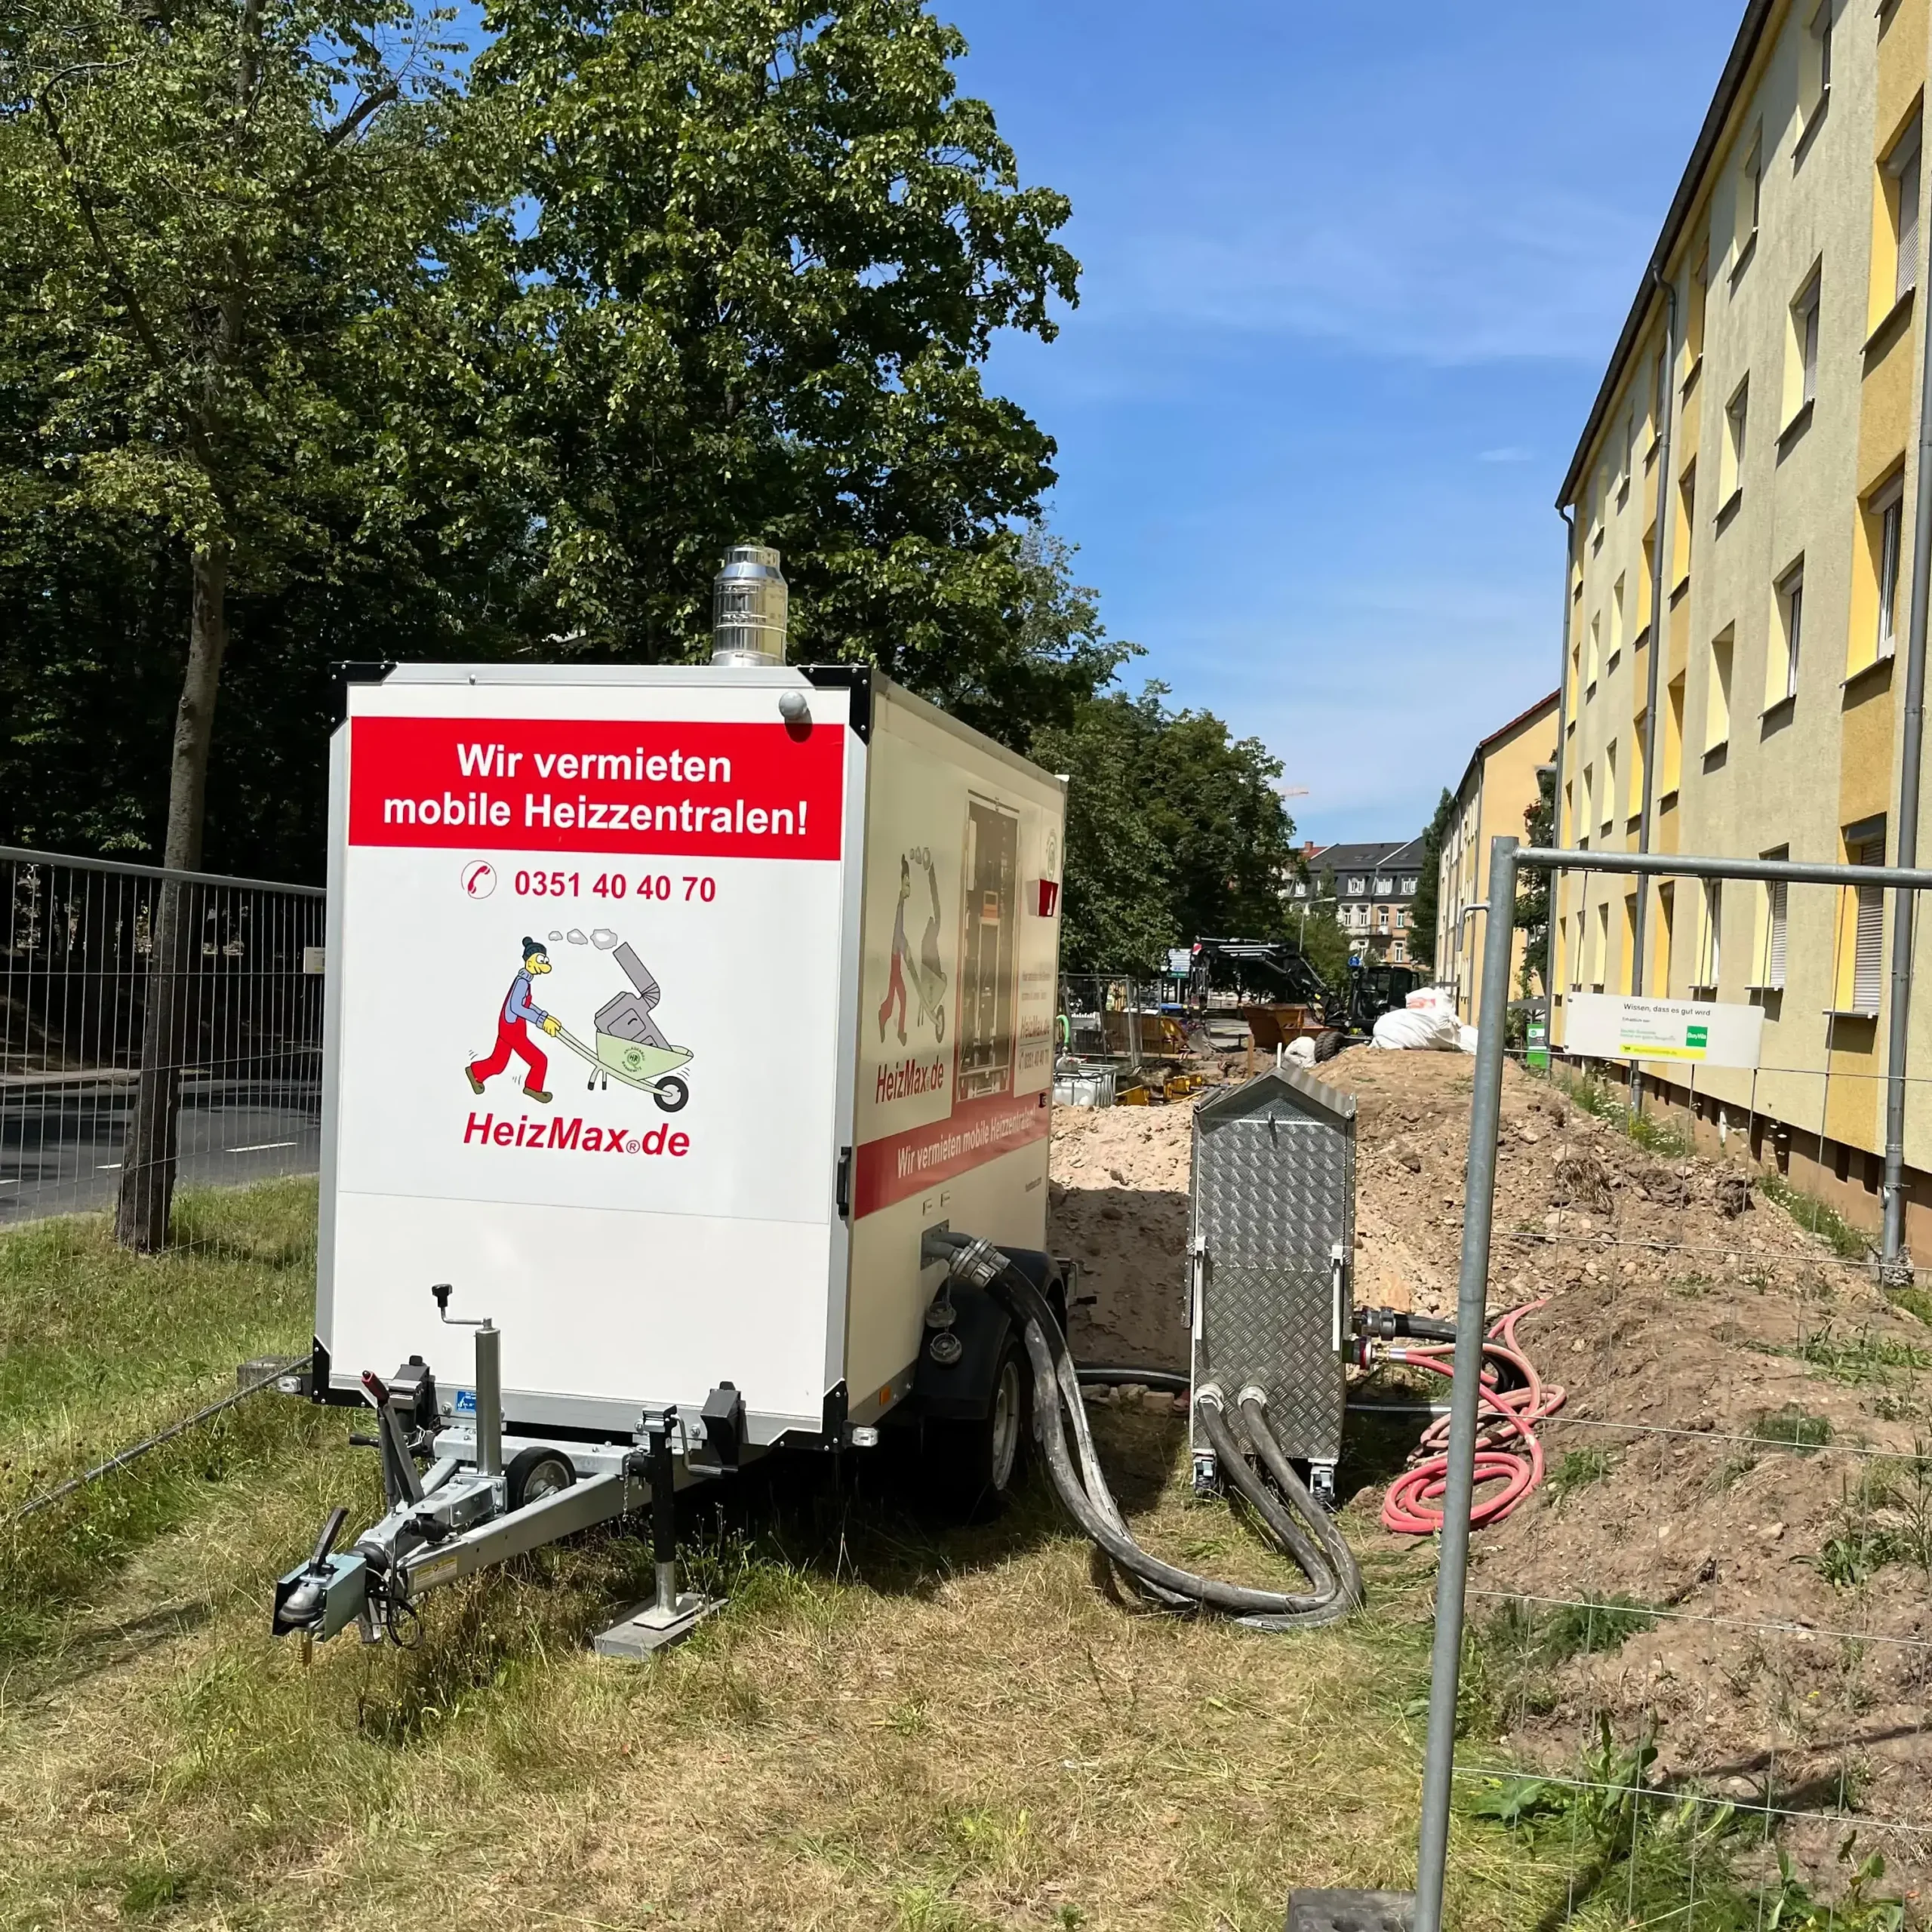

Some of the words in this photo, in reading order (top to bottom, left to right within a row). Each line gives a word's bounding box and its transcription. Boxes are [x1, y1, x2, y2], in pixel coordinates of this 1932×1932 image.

[457, 743, 523, 778] Wir
[534, 746, 731, 783] vermieten
[384, 792, 511, 827] mobile
[525, 793, 808, 835] Heizzentralen!
[515, 871, 580, 898] 0351
[592, 873, 627, 900] 40
[637, 875, 671, 901] 40
[682, 876, 716, 903] 70
[1624, 1003, 1651, 1012] Wissen,
[1681, 1008, 1693, 1016] gut
[897, 1144, 915, 1179] Wir
[917, 1134, 961, 1171] vermieten
[962, 1121, 989, 1154] mobile
